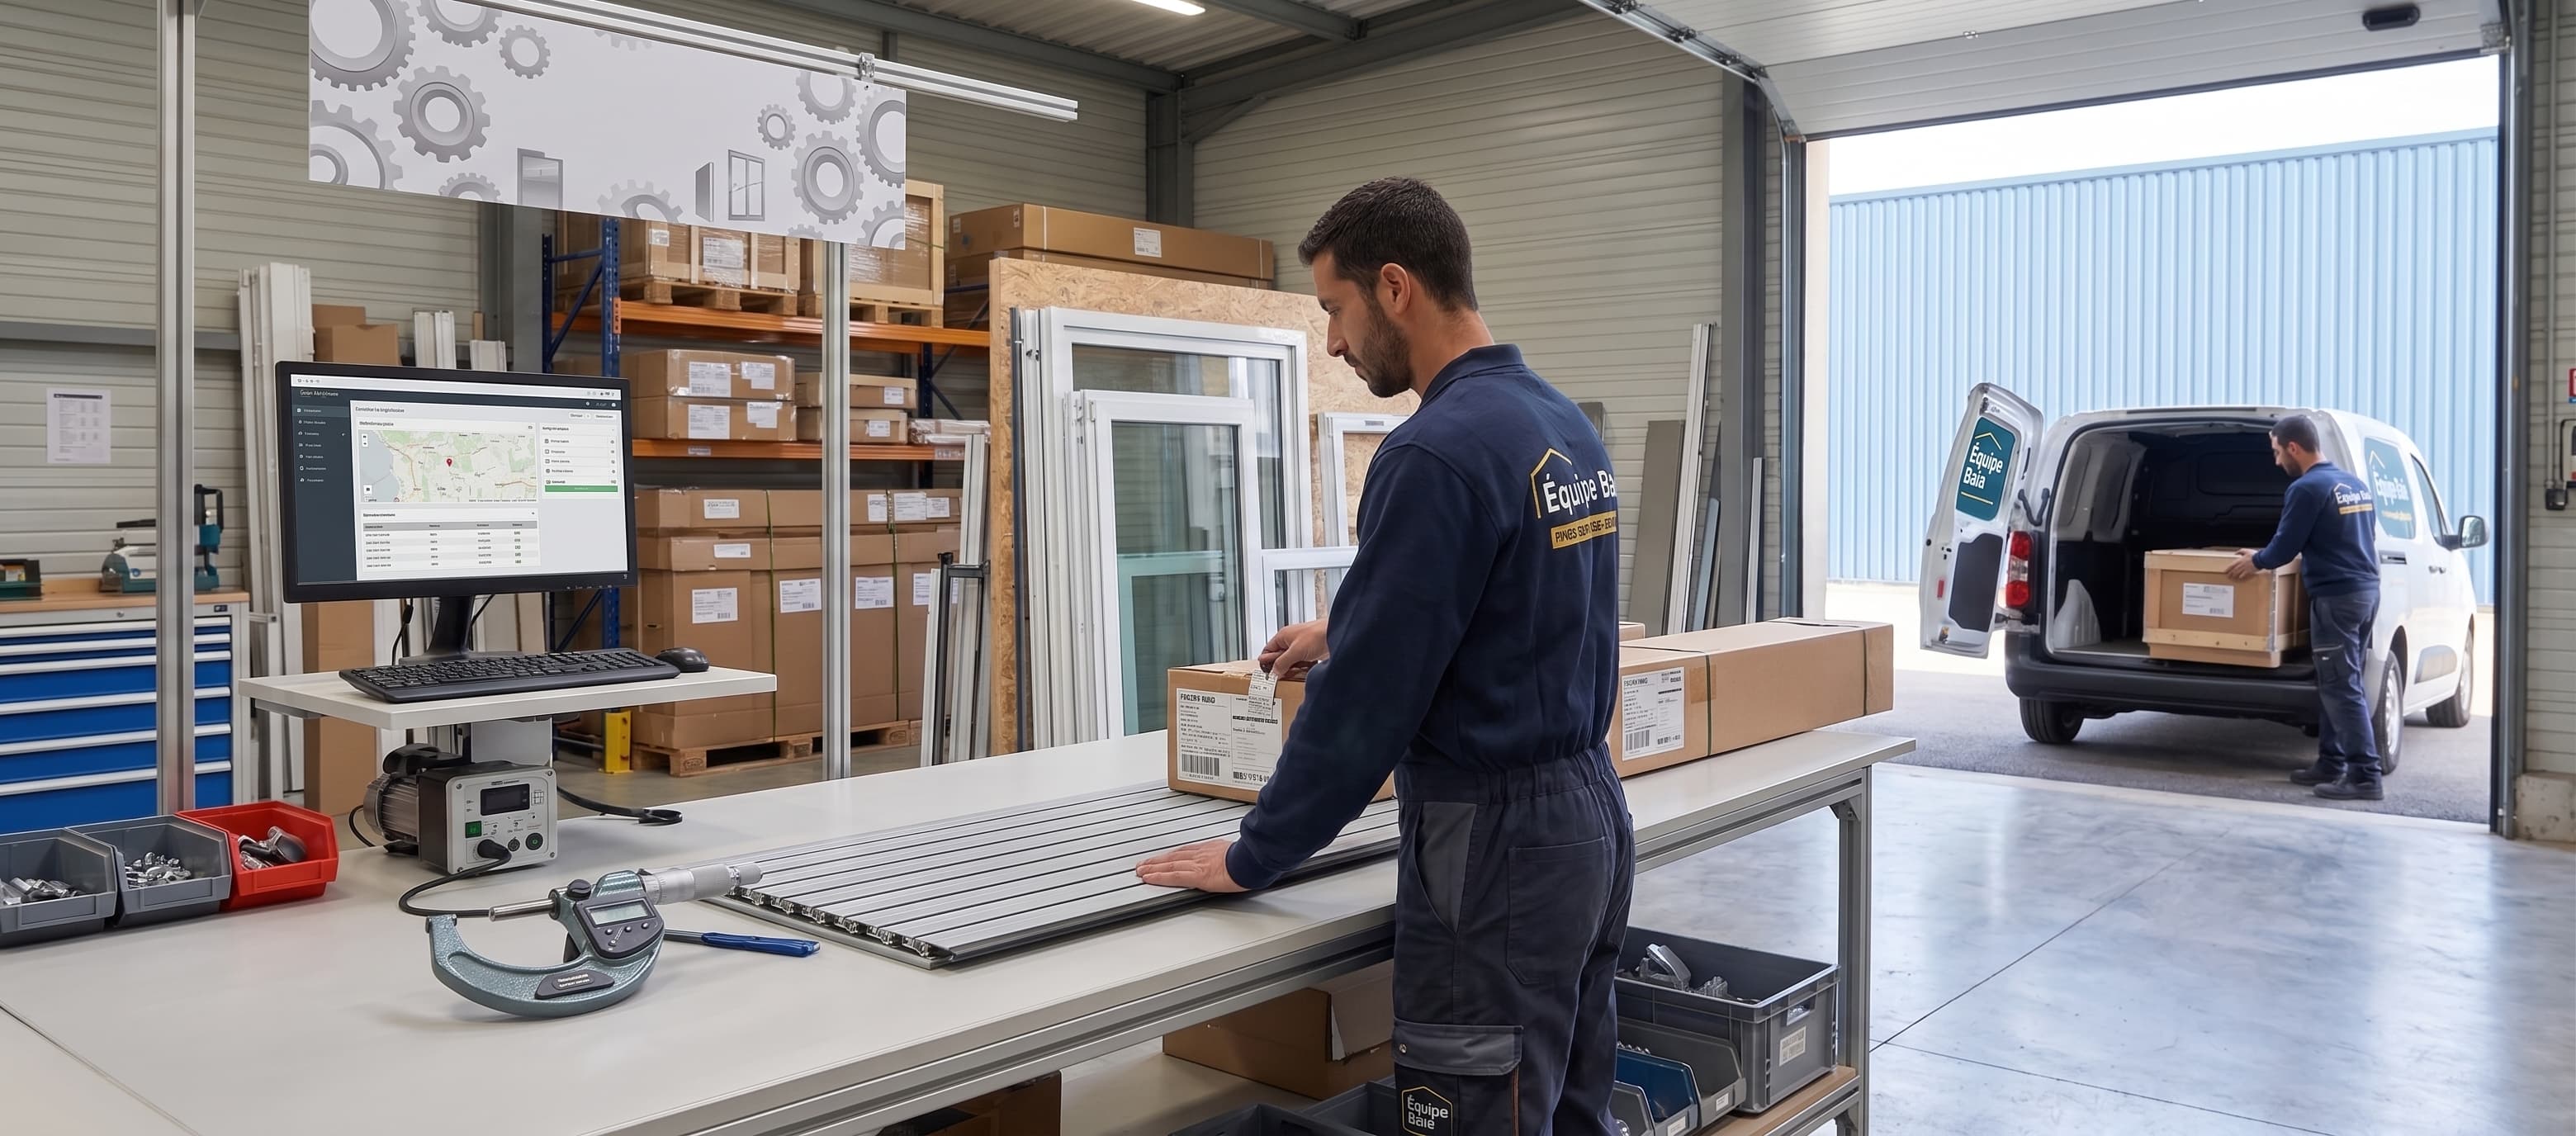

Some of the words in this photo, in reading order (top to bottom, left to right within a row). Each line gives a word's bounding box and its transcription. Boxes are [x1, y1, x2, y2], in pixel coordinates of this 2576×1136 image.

[1969, 443, 2003, 475] Équipe
[1963, 466, 1986, 489] Baia
[1542, 473, 1598, 515] Équipe
[1407, 1094, 1449, 1119] Équipe
